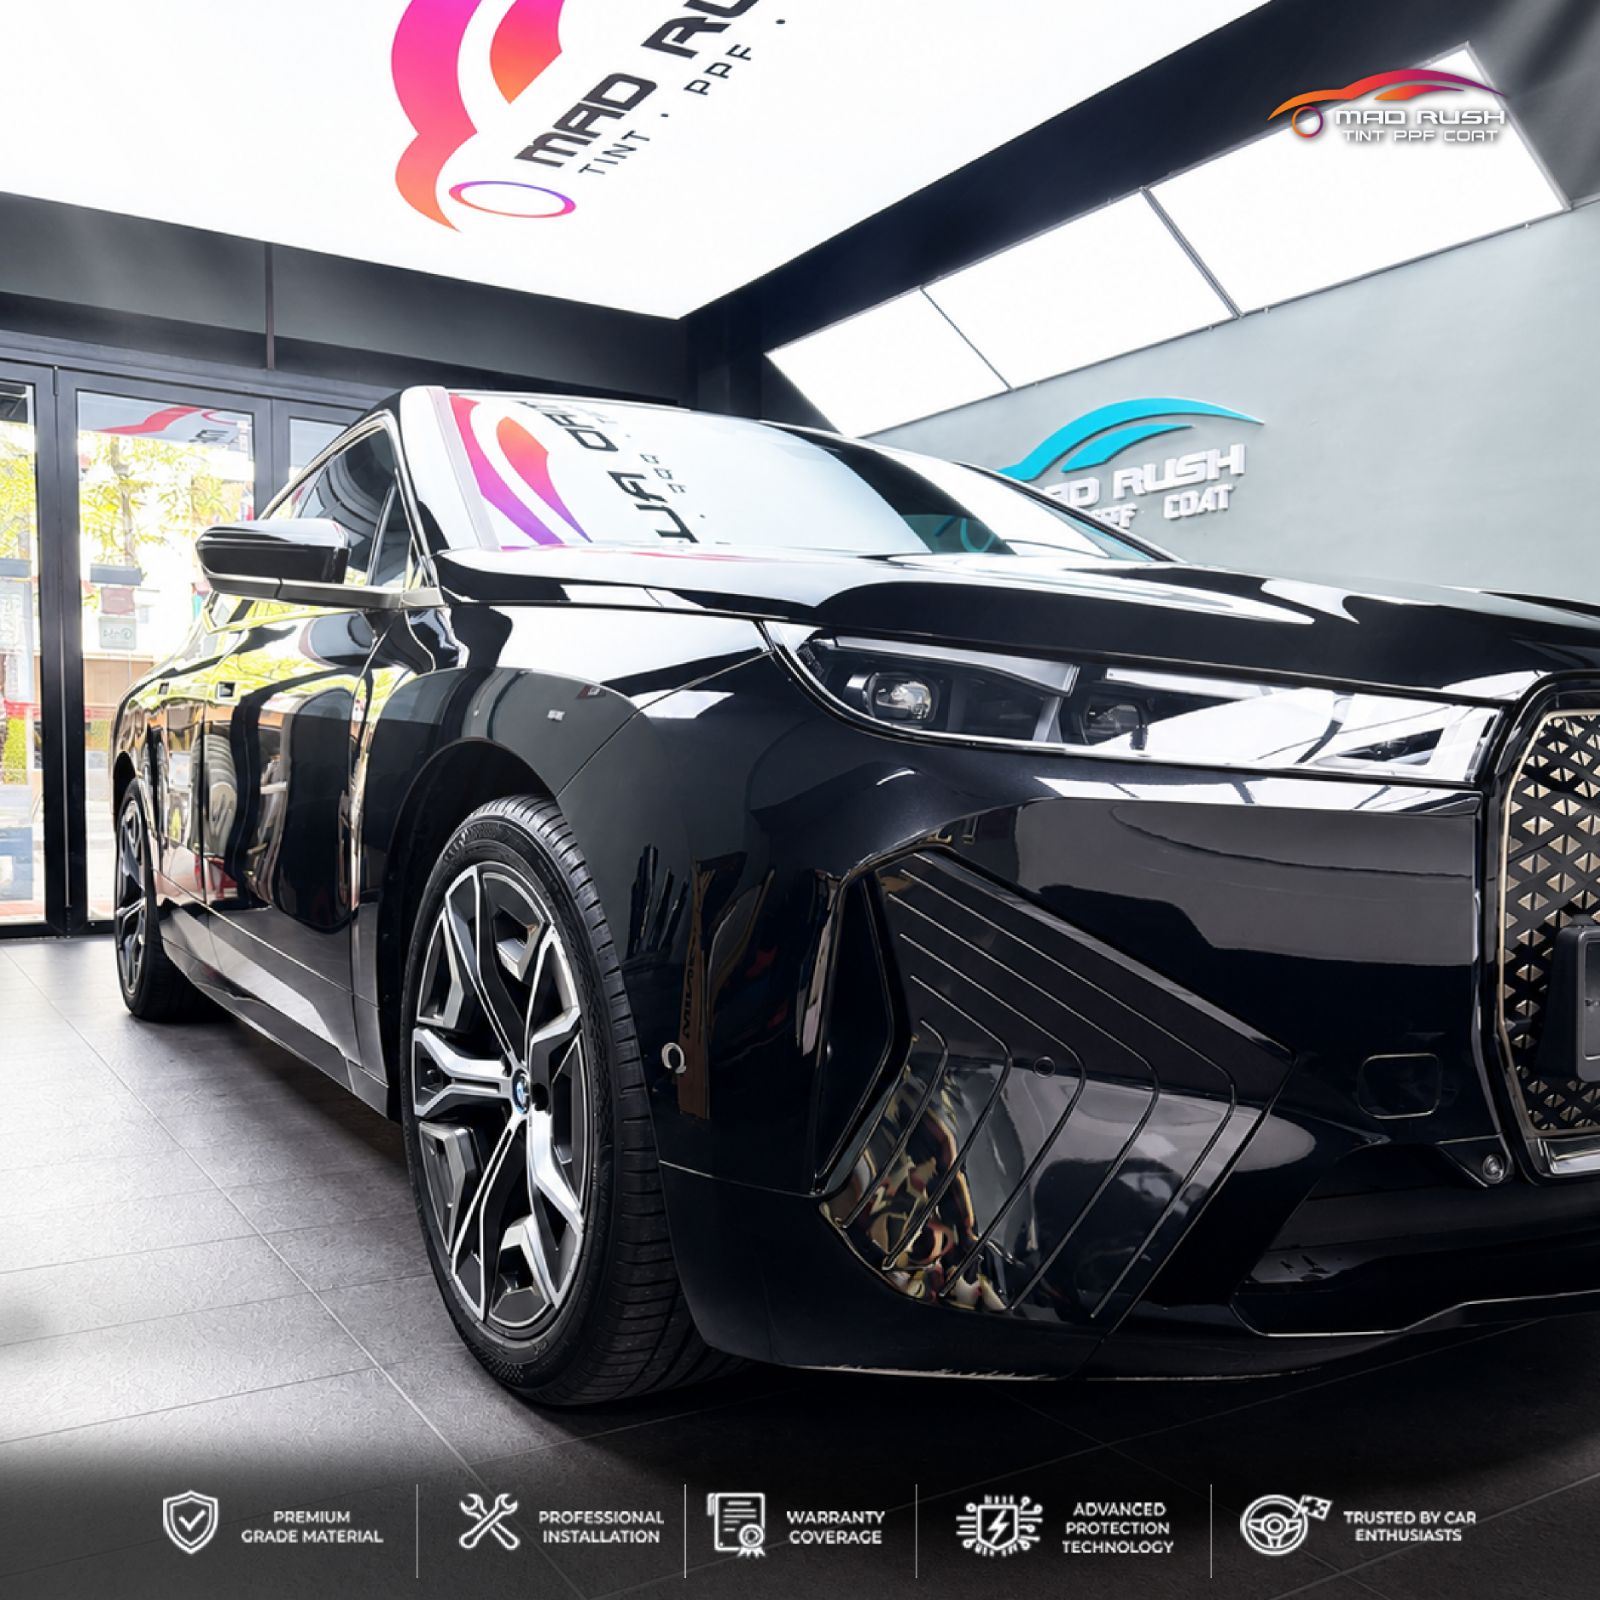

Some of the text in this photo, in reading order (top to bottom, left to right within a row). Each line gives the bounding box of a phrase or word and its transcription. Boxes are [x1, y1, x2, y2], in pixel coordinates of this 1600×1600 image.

[514, 72, 658, 168] MAD
[578, 44, 752, 175] TINT PPF
[1044, 443, 1246, 507] AD RUSH
[1164, 483, 1236, 520] COAT
